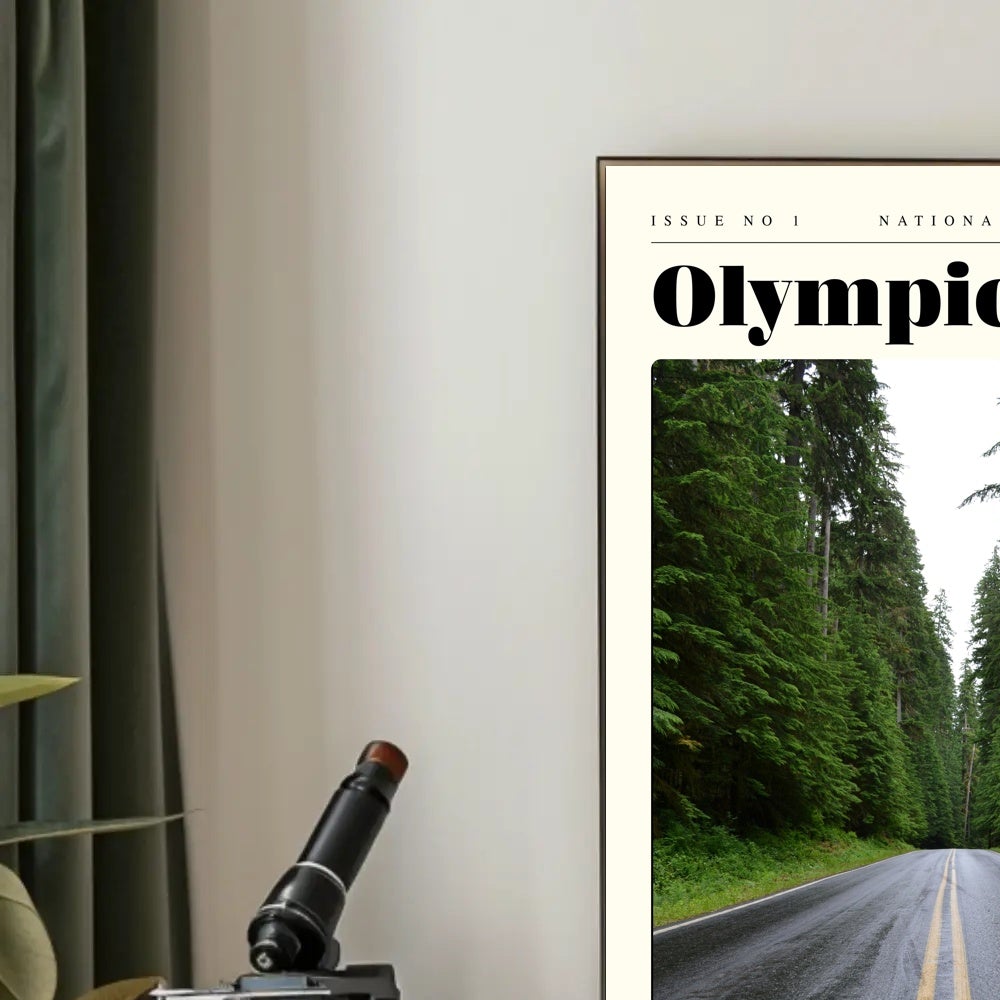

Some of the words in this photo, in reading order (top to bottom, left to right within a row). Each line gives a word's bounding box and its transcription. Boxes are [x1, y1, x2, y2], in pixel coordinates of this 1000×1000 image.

[651, 214, 724, 227] ISSUE
[743, 214, 773, 227] NO
[793, 215, 799, 227] 1
